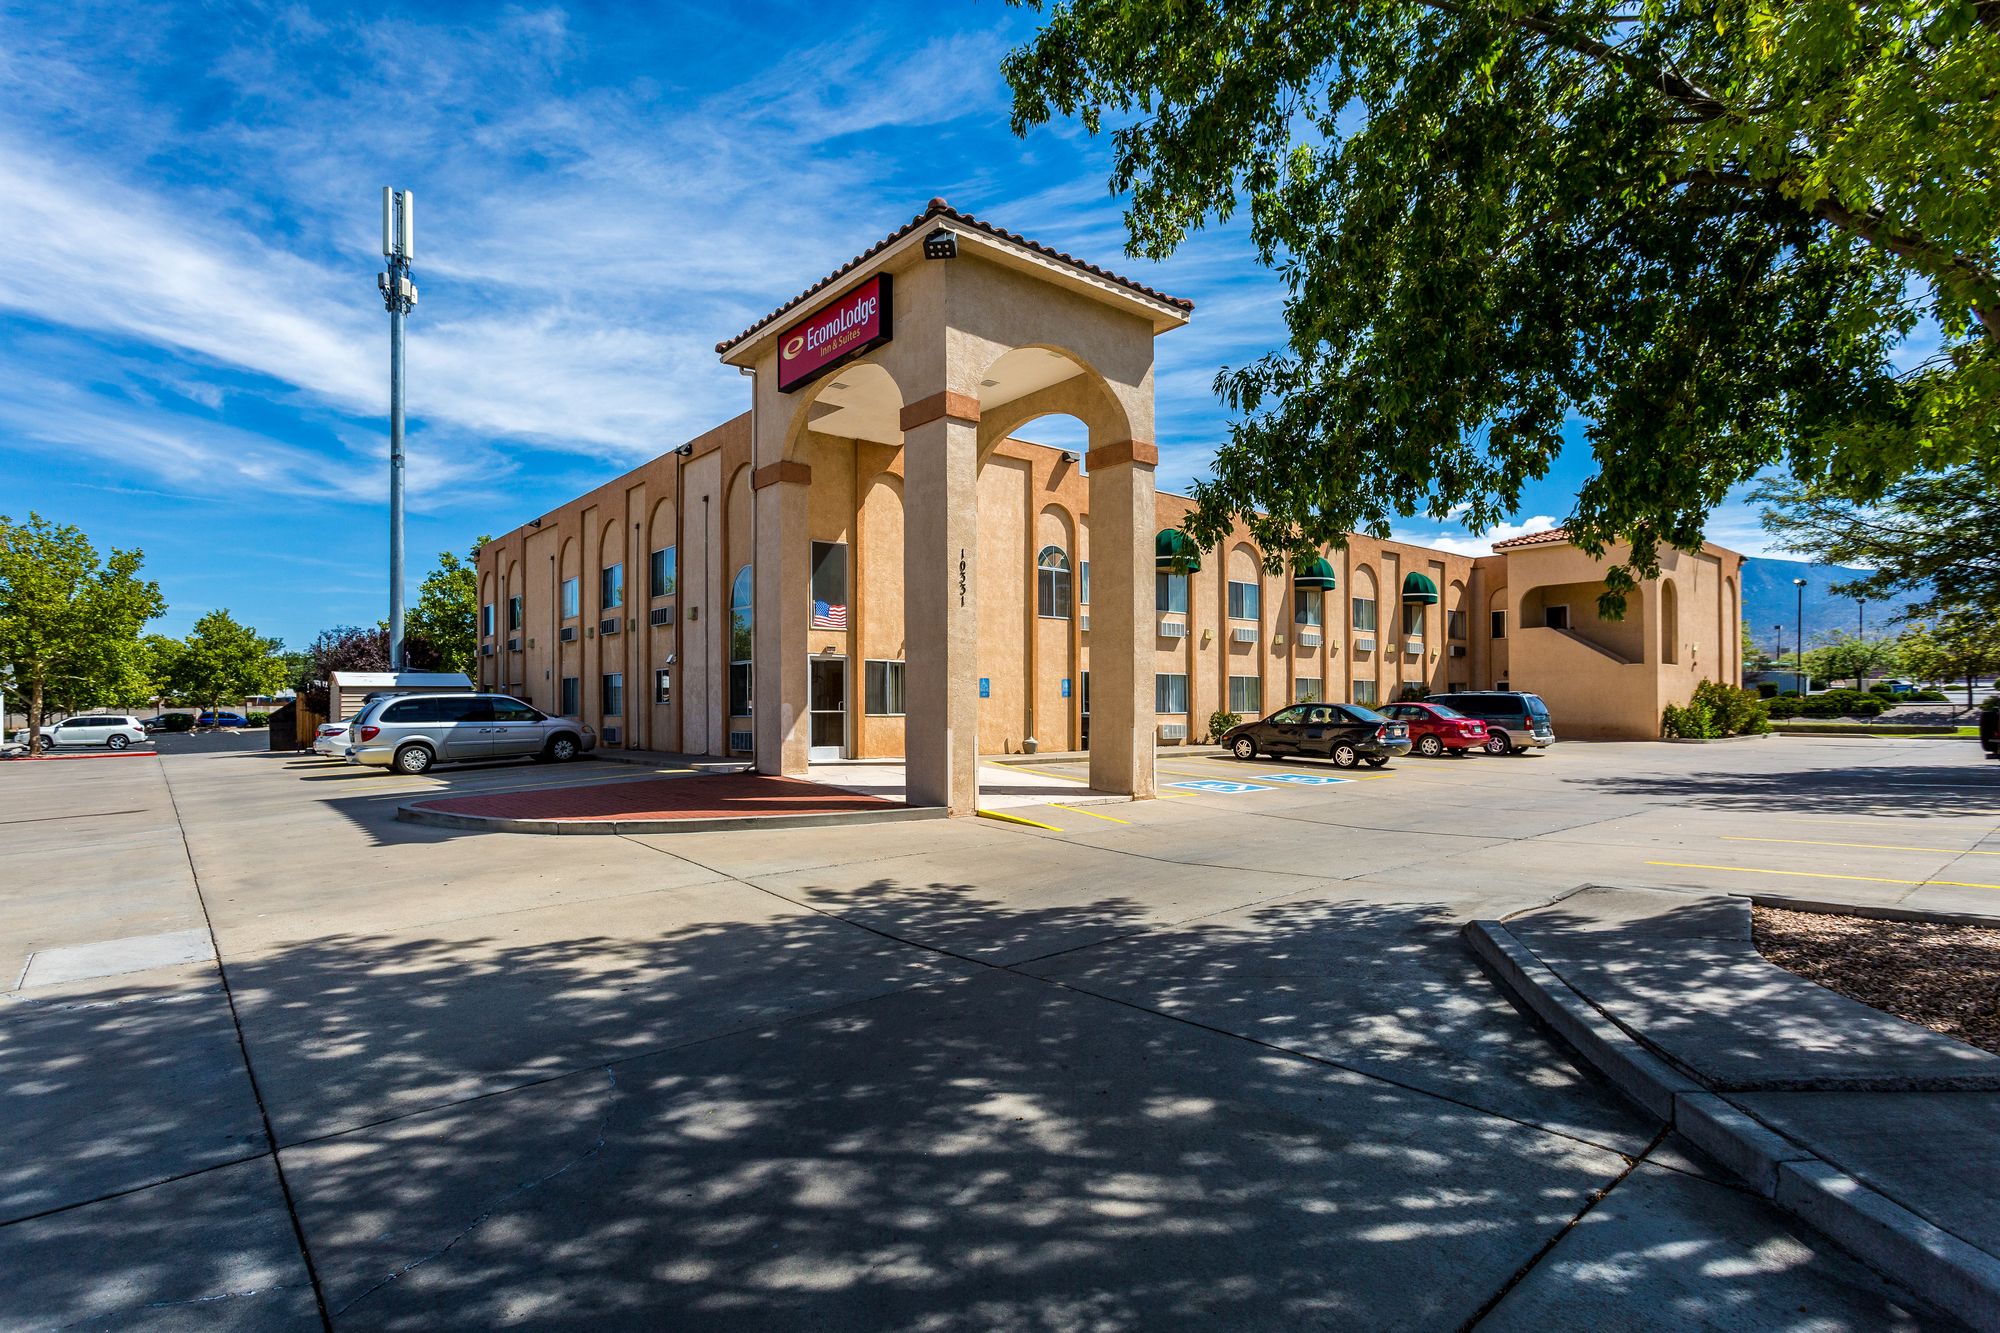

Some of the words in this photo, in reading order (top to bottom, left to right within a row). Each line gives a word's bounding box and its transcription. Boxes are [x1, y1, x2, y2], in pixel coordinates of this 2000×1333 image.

[807, 297, 876, 351] EconoLodge
[820, 344, 832, 358] Inn
[832, 339, 838, 350] &
[838, 328, 861, 347] Suites
